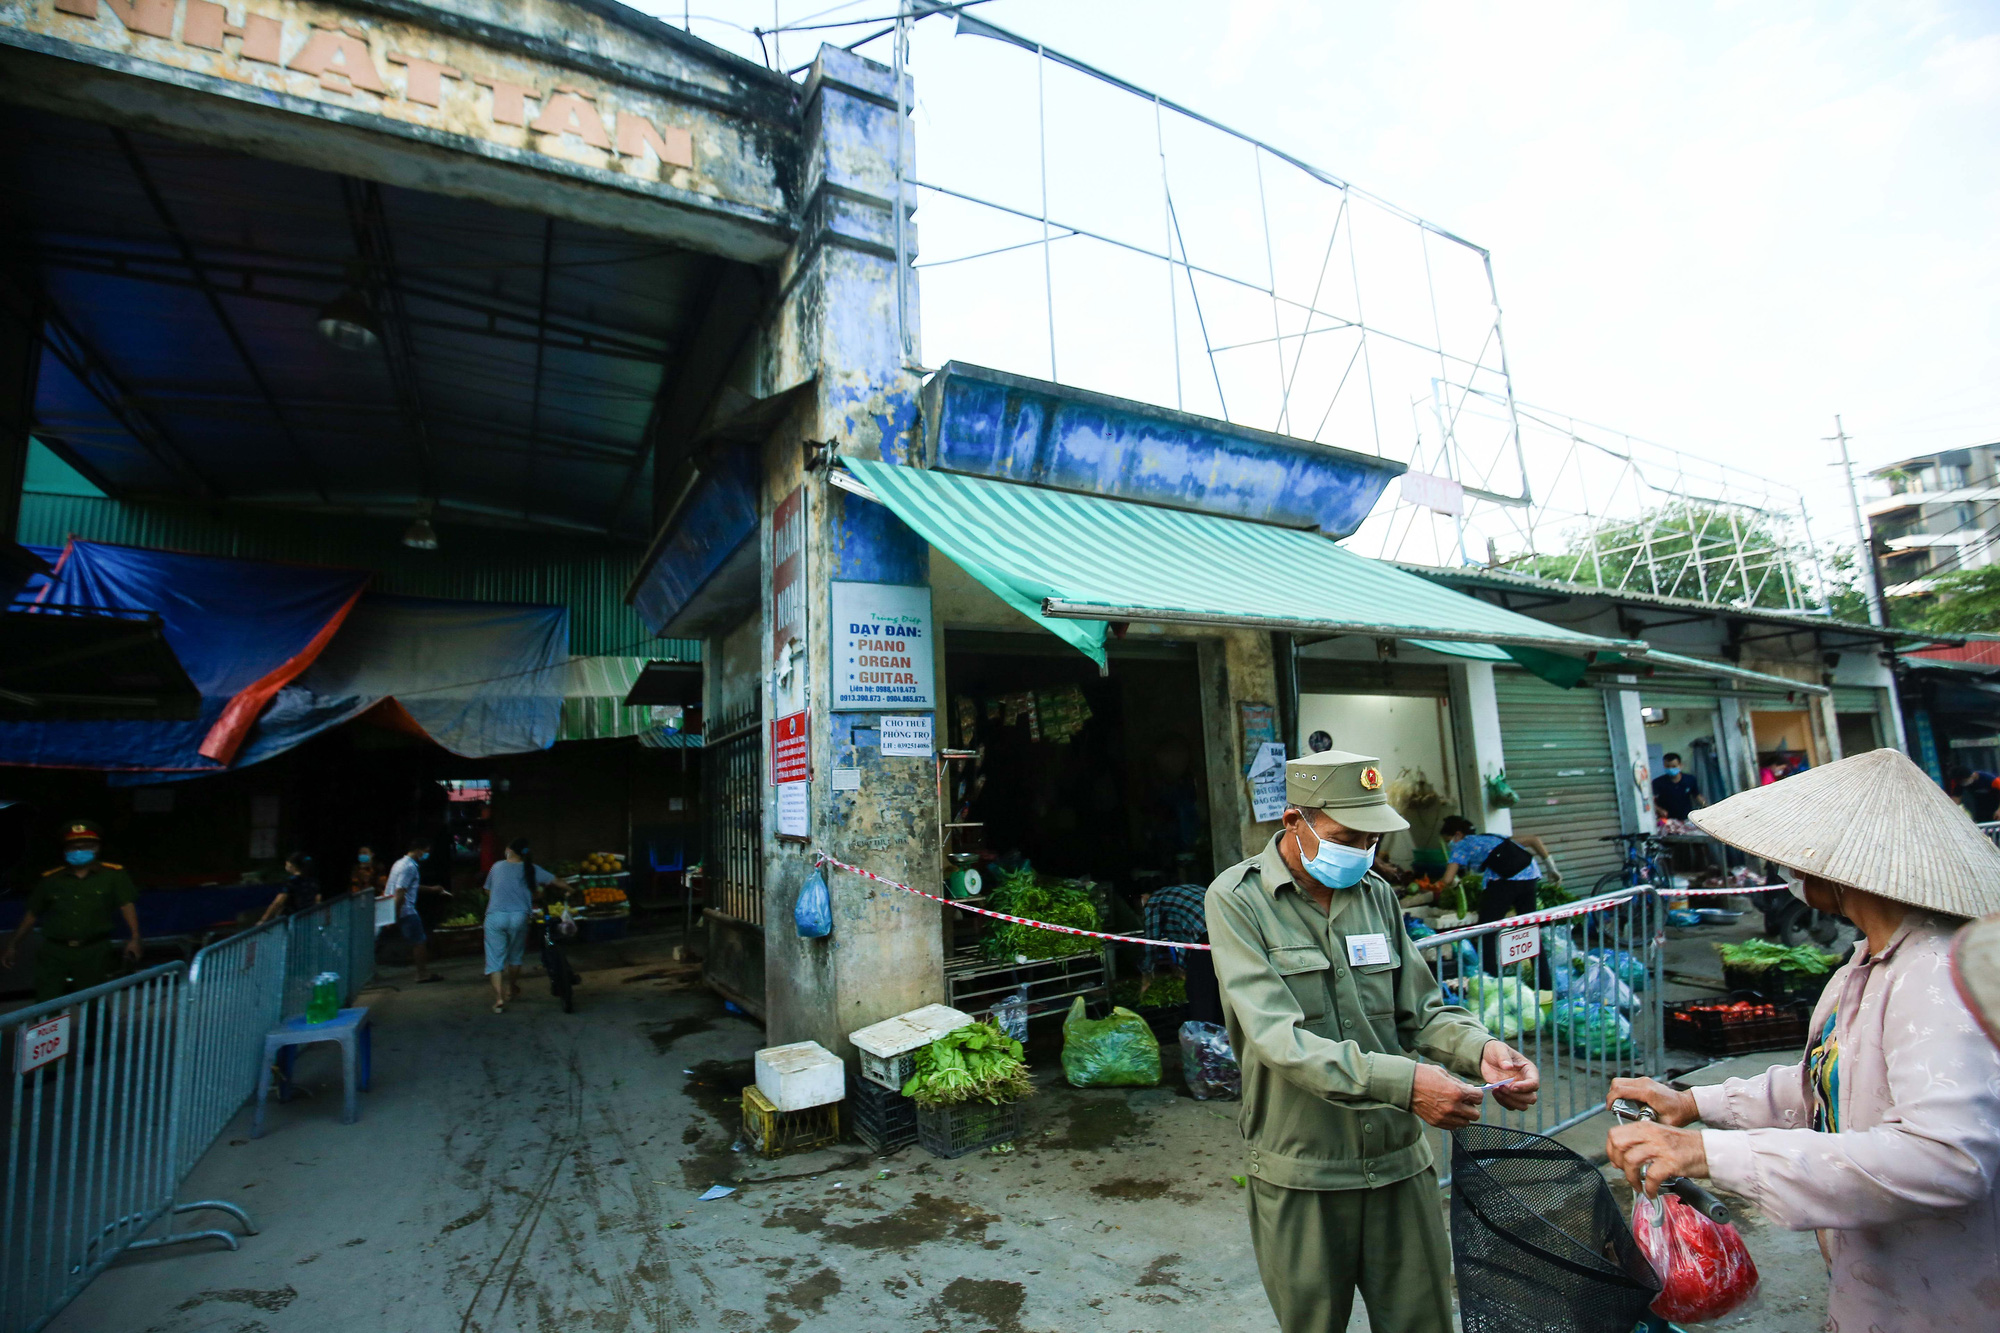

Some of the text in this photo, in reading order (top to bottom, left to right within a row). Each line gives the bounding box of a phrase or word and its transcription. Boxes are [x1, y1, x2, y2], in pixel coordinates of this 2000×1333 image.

[474, 71, 693, 168] TÂN
[777, 579, 798, 631] NON
[850, 623, 922, 637] DẠY ĐÀN:
[858, 639, 905, 652] PIANO
[859, 655, 911, 668] ORGAN
[859, 671, 918, 685] GUITAR.
[850, 685, 863, 693] Liên
[883, 730, 930, 740] PHÒNG TRỌ
[1512, 932, 1529, 940] POLICE
[1509, 941, 1532, 957] STOP
[33, 1037, 60, 1060] STOP
